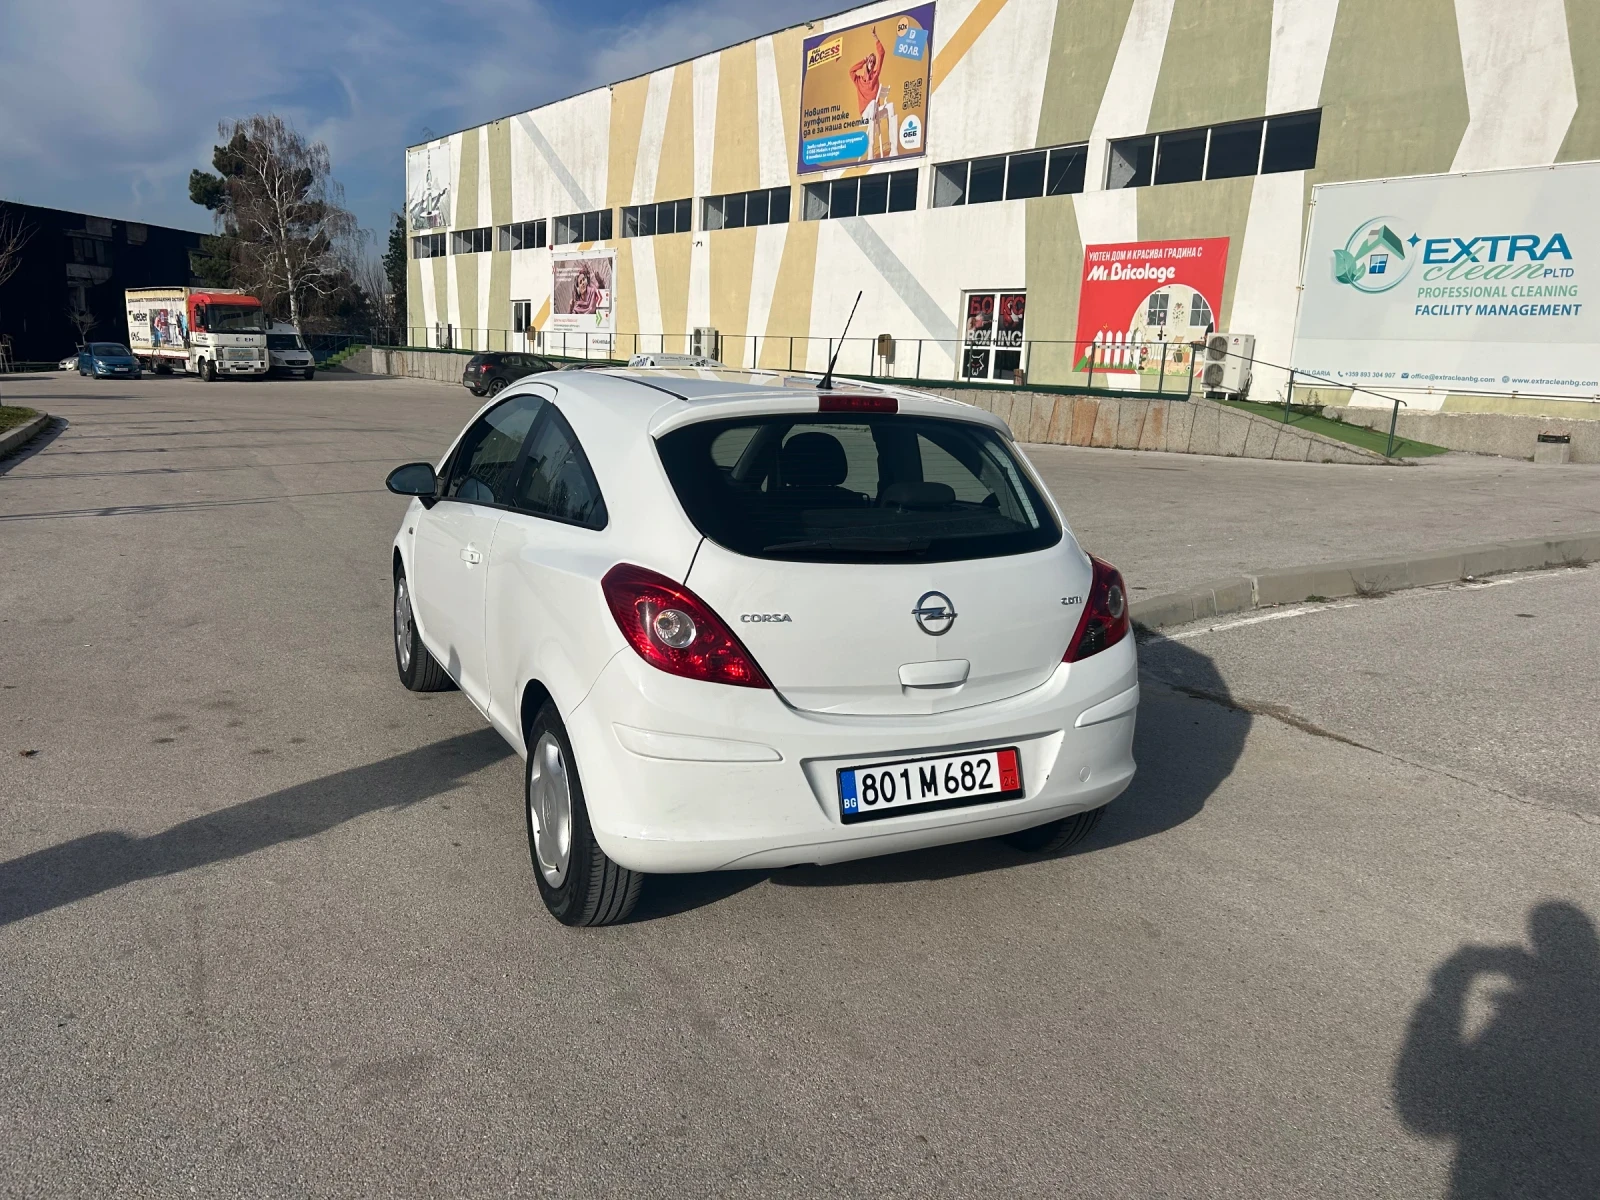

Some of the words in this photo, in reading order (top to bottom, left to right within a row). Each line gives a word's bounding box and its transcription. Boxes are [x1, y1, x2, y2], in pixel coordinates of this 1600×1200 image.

[809, 44, 840, 65] ACCESS
[804, 107, 830, 118] Новият
[830, 104, 841, 112] ти
[831, 111, 850, 121] може
[824, 123, 842, 132] наша
[1089, 251, 1111, 261] УЮТЕН
[1111, 250, 1126, 261] ДОМ
[1127, 250, 1132, 260] И
[1132, 248, 1163, 260] КРАСИВА
[1163, 247, 1196, 259] ГРАДИНА
[1197, 246, 1203, 257] С
[1422, 233, 1573, 264] EXTRA
[1422, 245, 1545, 281] clean
[1543, 267, 1574, 278] PLTD
[1417, 285, 1508, 298] PROFESSIONAL
[1511, 284, 1579, 297] CLEANING
[1414, 304, 1473, 316] FACILITY
[1475, 303, 1583, 316] MANAGEMENT
[1410, 373, 1496, 384] office@extracleanbg.com
[1511, 376, 1599, 388] www.extracleanbg.com
[740, 613, 793, 623] CORSA
[1003, 776, 1015, 787] 26
[844, 797, 857, 809] BG
